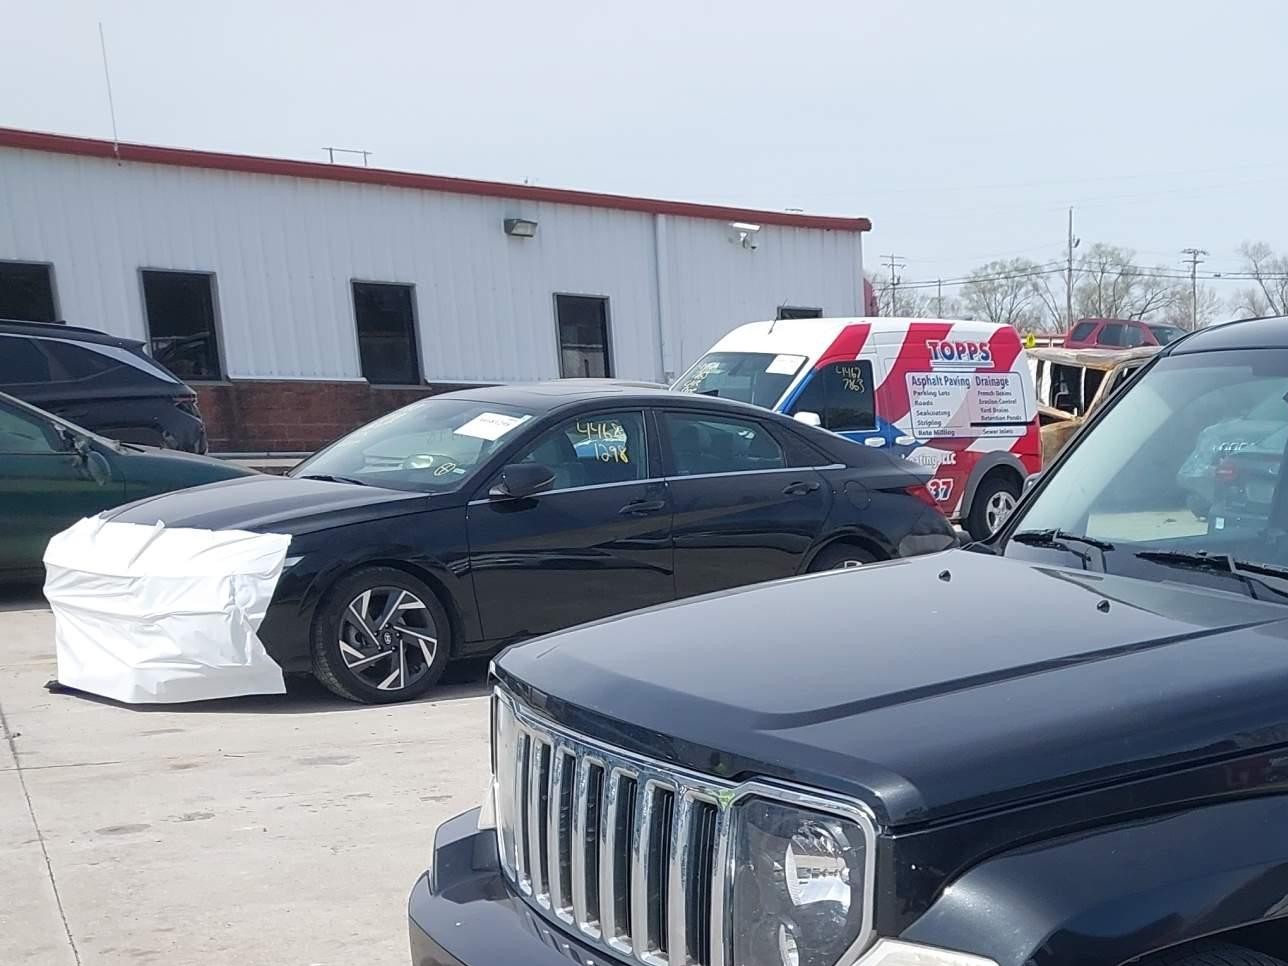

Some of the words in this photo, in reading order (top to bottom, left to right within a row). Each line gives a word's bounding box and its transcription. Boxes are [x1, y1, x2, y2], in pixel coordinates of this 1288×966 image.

[927, 341, 991, 361] TOPPS
[911, 376, 944, 391] Asphalt
[944, 376, 970, 389] Paving
[975, 376, 1009, 389] Drainage
[926, 478, 954, 501] 37
